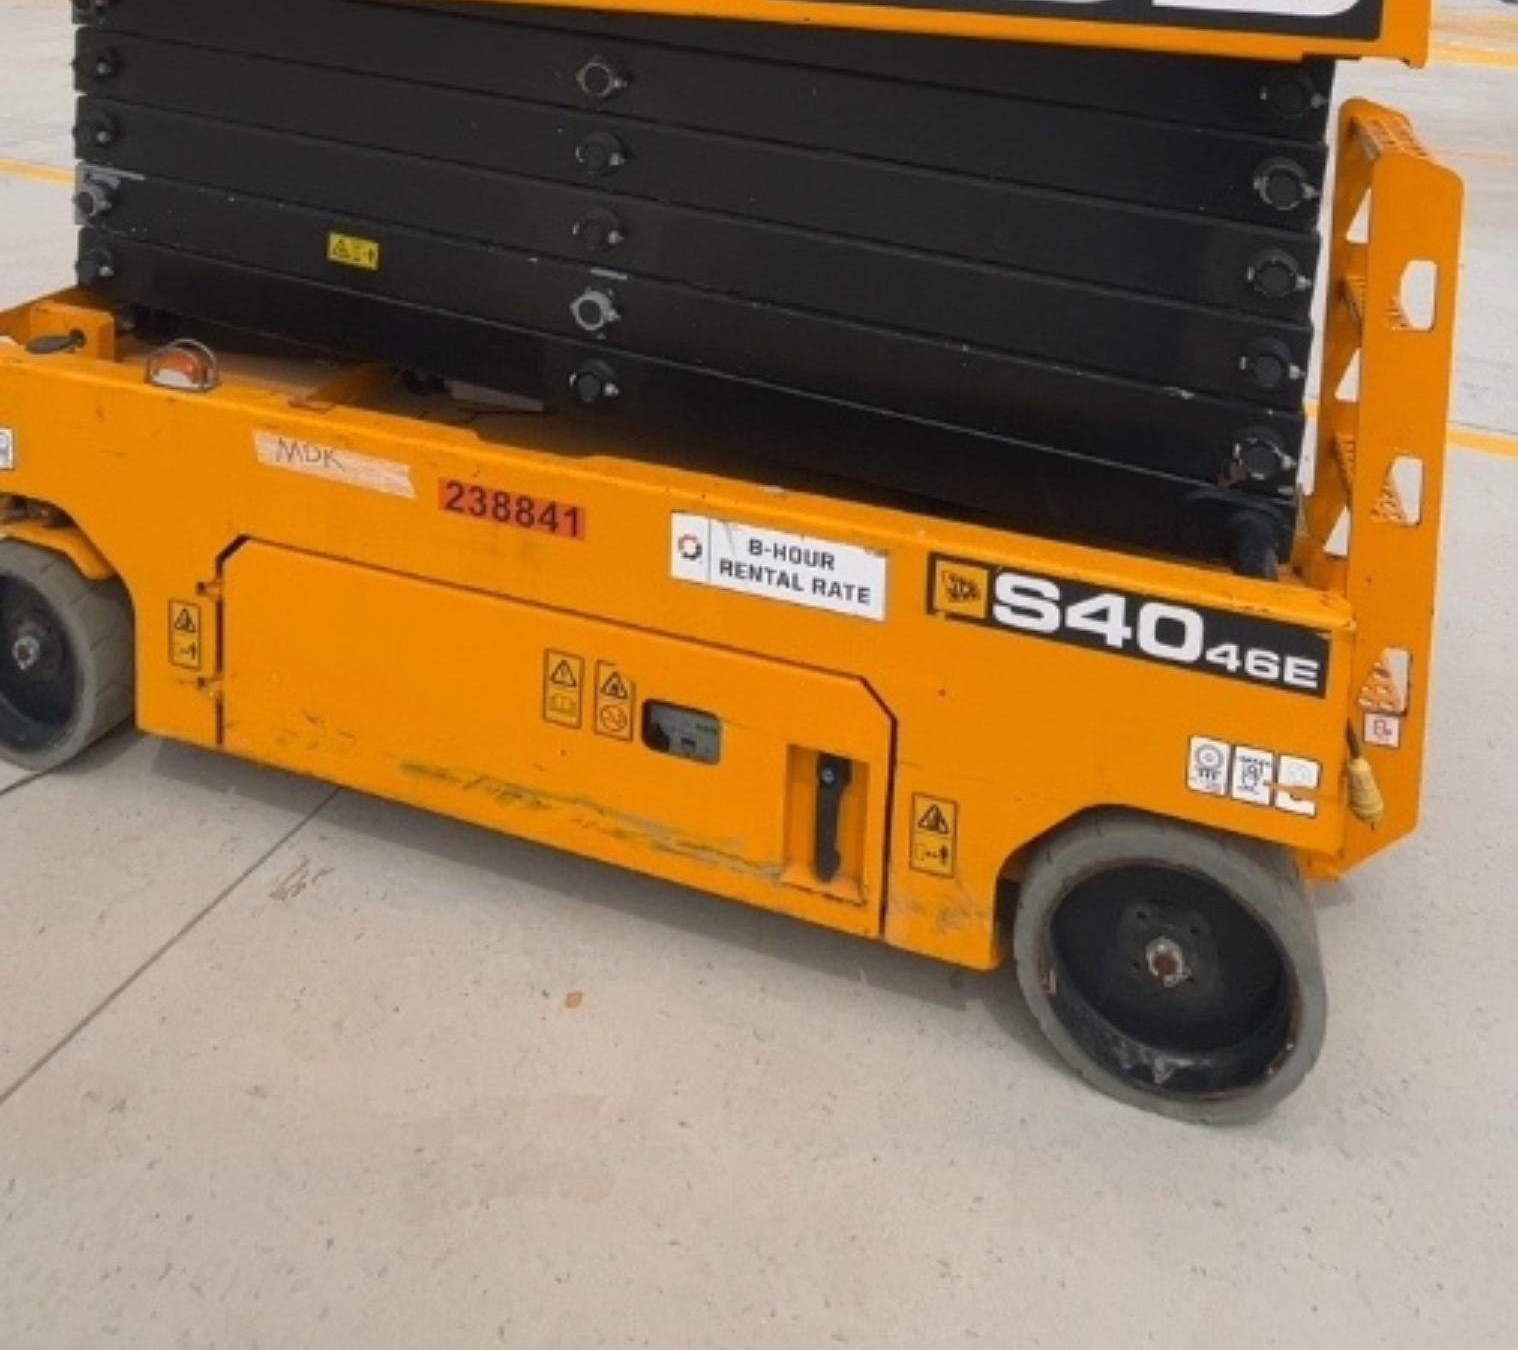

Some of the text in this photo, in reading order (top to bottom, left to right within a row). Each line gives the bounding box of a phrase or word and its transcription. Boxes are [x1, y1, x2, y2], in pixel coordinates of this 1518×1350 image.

[275, 437, 345, 471] MDK
[445, 479, 579, 538] 238841
[719, 558, 871, 605] RENTAL RATE
